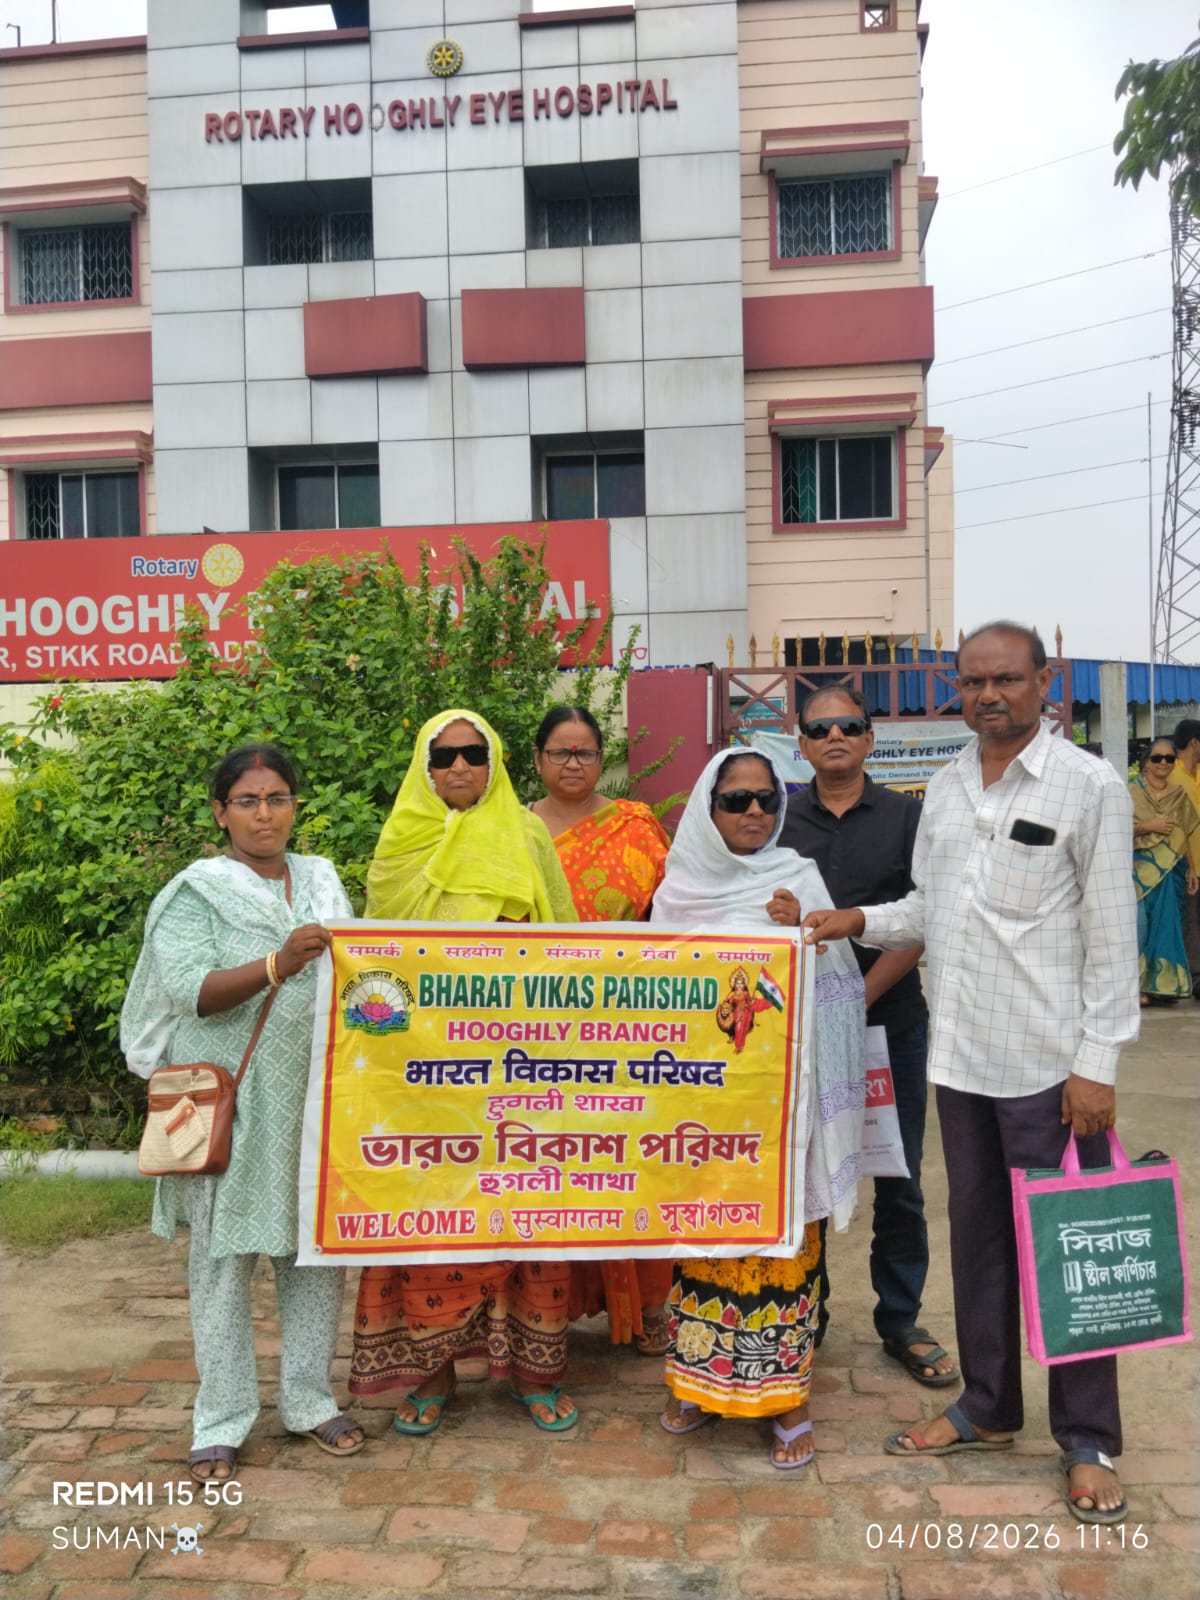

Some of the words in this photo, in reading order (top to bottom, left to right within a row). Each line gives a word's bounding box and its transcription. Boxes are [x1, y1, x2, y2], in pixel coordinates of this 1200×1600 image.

[204, 104, 315, 142] ROTARY
[470, 89, 524, 124] EYE
[532, 78, 678, 120] HOSPITAL
[131, 555, 199, 579] Rotary
[0, 591, 230, 637] HOOGHLY
[26, 644, 100, 668] STKK
[909, 746, 935, 757] EYE
[347, 941, 402, 958] सम्पर्क
[444, 942, 504, 960] सहयोग
[545, 943, 602, 960] संस्कार
[641, 945, 677, 961] सेवा
[716, 949, 772, 964] समर्पण
[419, 973, 517, 1009] BHARAT
[523, 974, 595, 1010] VIKAS
[602, 975, 719, 1011] PARISHAD
[448, 1020, 573, 1042] HOOGHLY
[579, 1022, 687, 1043] BRANCH
[406, 1058, 493, 1086] भारत
[502, 1048, 618, 1085] विकास
[627, 1049, 728, 1087] परिषद
[486, 1088, 564, 1121] हुगली
[574, 1094, 646, 1112] शाखा
[361, 1135, 484, 1170] ভারত
[494, 1120, 628, 1164] বিকাশ
[638, 1122, 762, 1168] পরিষদ
[478, 1165, 562, 1195] হুগলী
[569, 1172, 637, 1192] শাখা
[337, 1209, 477, 1240] WELCOME
[511, 1208, 625, 1240] सुस्वागतम
[1057, 1228, 1152, 1256] সিরাজ
